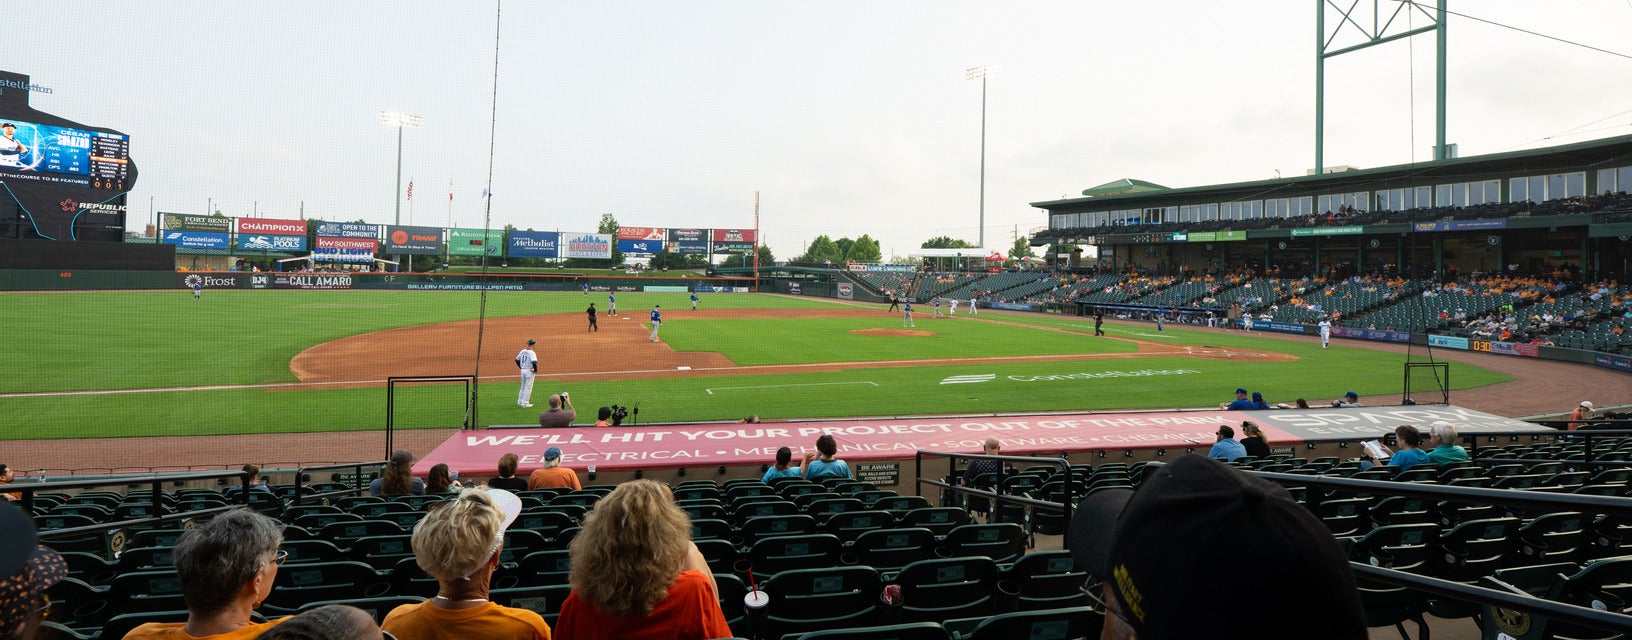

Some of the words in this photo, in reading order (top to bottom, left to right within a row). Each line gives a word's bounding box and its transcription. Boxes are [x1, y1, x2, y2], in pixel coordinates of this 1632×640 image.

[79, 202, 128, 211] REPUBLIC
[274, 240, 300, 248] POOLS
[513, 238, 555, 248] Methodist
[204, 275, 235, 287] Frost
[289, 276, 314, 286] CALL
[315, 276, 352, 286] AMARO
[1007, 368, 1201, 383] Constellation
[466, 432, 590, 447] WE'LL
[601, 430, 672, 444] HIT
[679, 427, 791, 441] YOUR
[797, 421, 953, 438] PROJECT
[960, 420, 1031, 432] OUT
[1037, 418, 1081, 430] OF
[1087, 416, 1151, 428] THE
[1148, 414, 1239, 426] PARK
[518, 448, 708, 465] EECTRICAL
[734, 441, 926, 458] MECHNICAL
